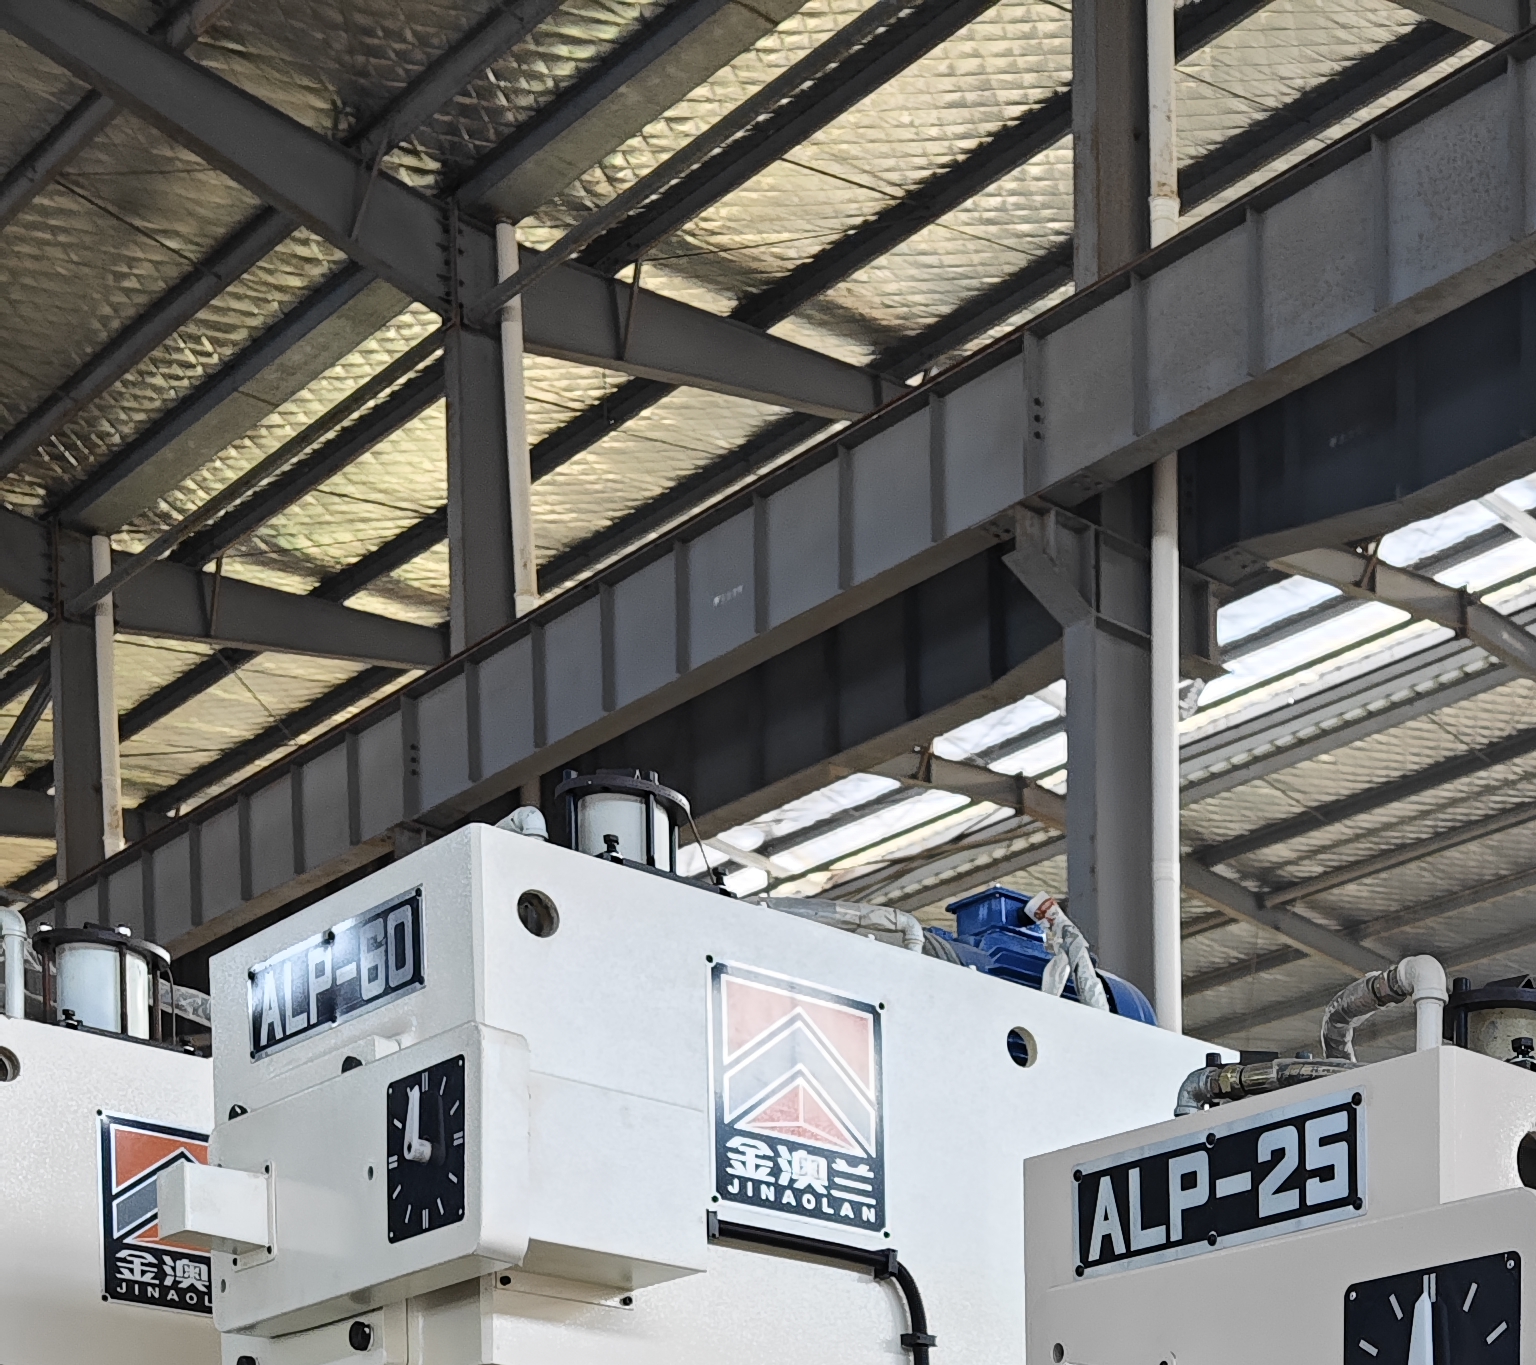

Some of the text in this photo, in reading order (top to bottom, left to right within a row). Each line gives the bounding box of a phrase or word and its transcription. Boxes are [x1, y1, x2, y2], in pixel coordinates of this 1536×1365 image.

[259, 903, 415, 1047] ALP-60
[725, 1135, 877, 1205] 金澳兰
[727, 1177, 876, 1223] JINAOLAN
[1087, 1109, 1350, 1262] ALP-25
